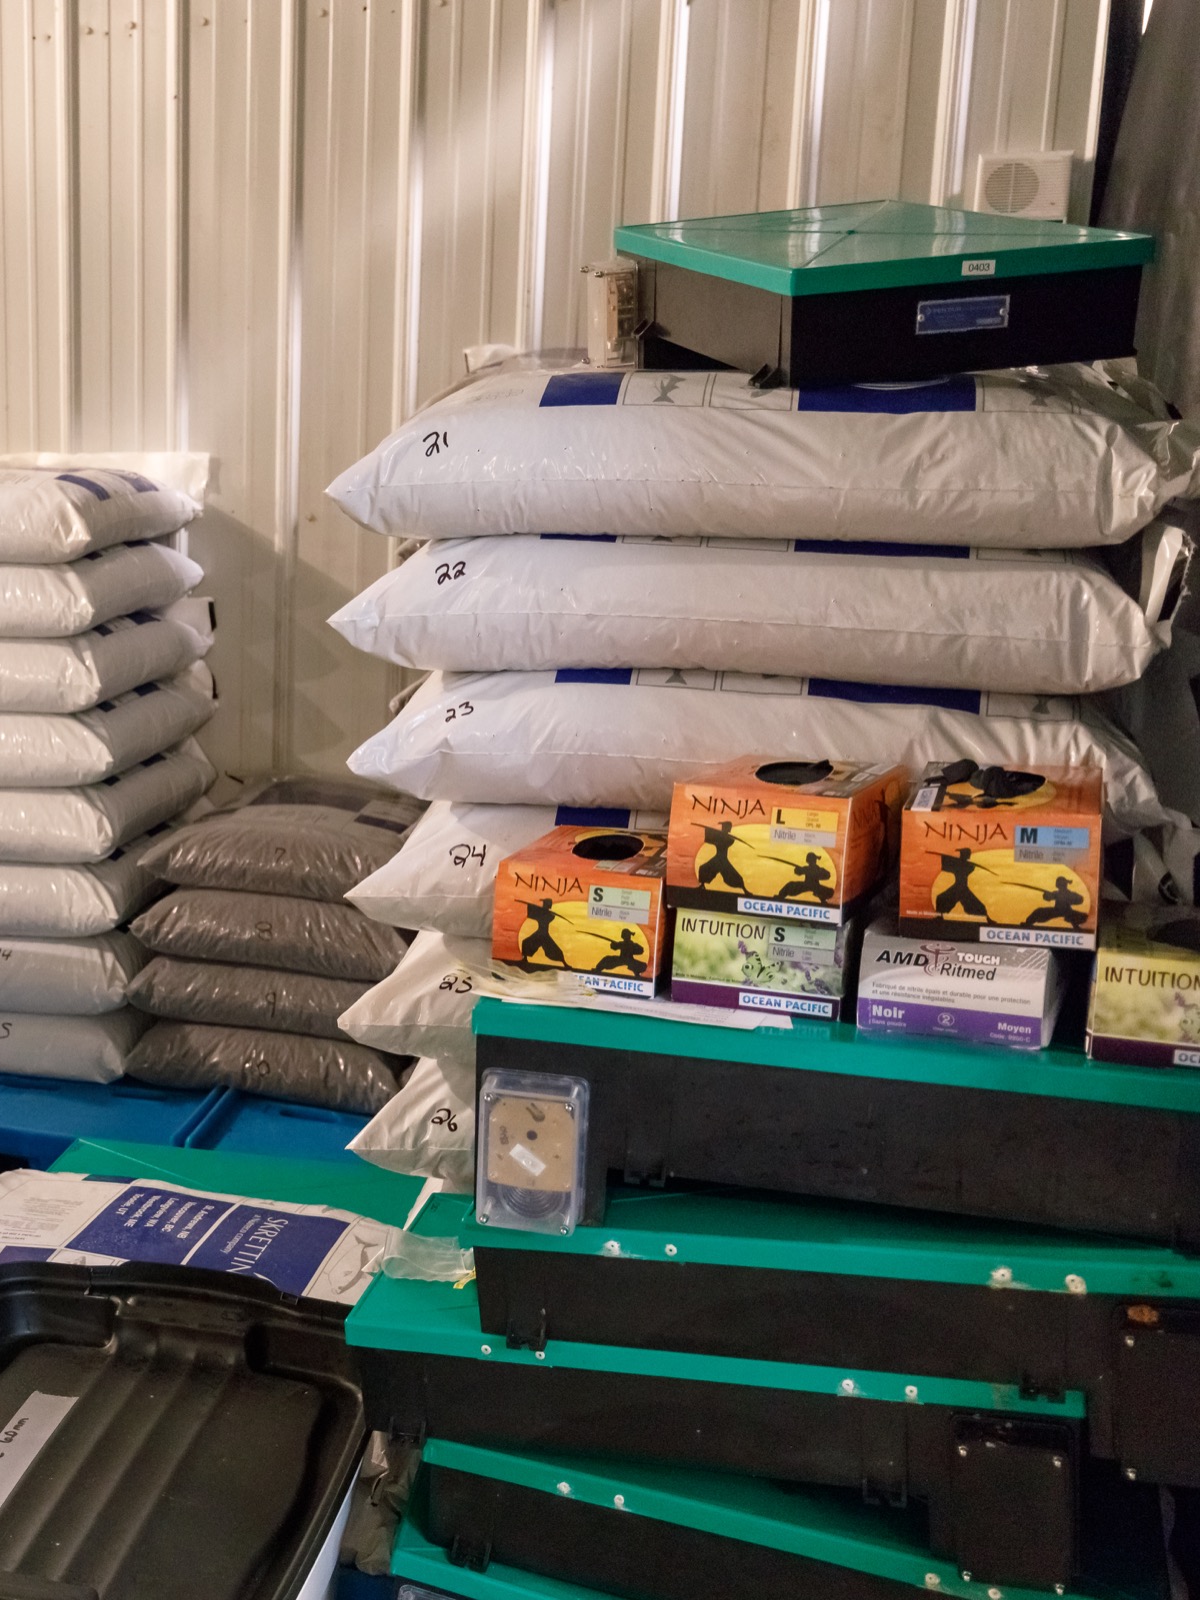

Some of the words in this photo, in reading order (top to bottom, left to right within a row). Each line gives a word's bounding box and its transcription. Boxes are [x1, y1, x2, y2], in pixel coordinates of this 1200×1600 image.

[968, 263, 991, 272] 0403
[422, 431, 449, 457] 21
[435, 561, 467, 586] 22
[445, 701, 474, 723] 23
[691, 794, 766, 820] NINJA
[776, 809, 785, 825] L
[773, 829, 796, 841] Nitrile
[924, 821, 1008, 845] NINJA
[1020, 828, 1038, 844] M
[274, 847, 286, 863] 7
[449, 843, 487, 868] 24
[1019, 849, 1044, 861] Nitrile
[514, 872, 584, 896] NINJA
[592, 887, 604, 903] S
[591, 906, 612, 919] Nitrile
[743, 900, 783, 914] OCEAN
[786, 905, 830, 920] PACIFIC
[255, 921, 273, 941] 8
[681, 917, 767, 940] INTUITION
[774, 926, 786, 943] S
[986, 930, 1031, 942] OCEAN
[1035, 932, 1084, 946] PACIFIC
[772, 946, 795, 958] Nitrile
[876, 950, 929, 967] AMD
[956, 952, 1000, 966] TOUGH
[940, 963, 997, 981] Ritmed
[439, 973, 473, 994] 25
[266, 991, 277, 1019] 9
[742, 995, 782, 1008] OCEAN
[785, 1000, 829, 1014] PACIFIC
[950, 990, 971, 998] durable
[973, 993, 987, 1001] pour
[1000, 995, 1031, 1005] protection
[872, 1004, 905, 1019] Noir
[997, 1022, 1032, 1035] Moyen
[431, 1108, 458, 1133] 26
[116, 1207, 128, 1215] UT
[124, 1219, 138, 1228] ME
[144, 1219, 159, 1227] WA
[161, 1223, 175, 1232] BC
[225, 1216, 289, 1274] SKRETTIN
